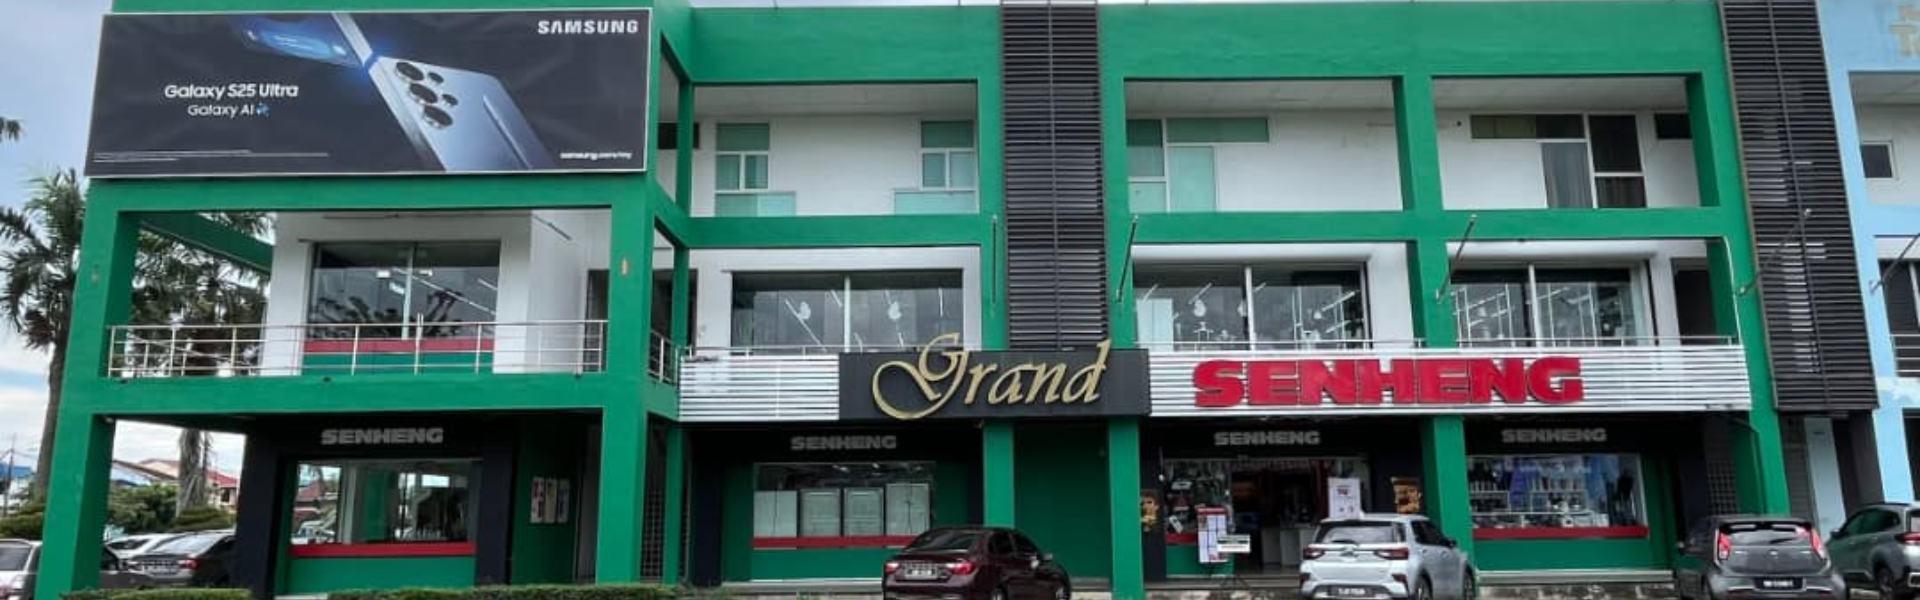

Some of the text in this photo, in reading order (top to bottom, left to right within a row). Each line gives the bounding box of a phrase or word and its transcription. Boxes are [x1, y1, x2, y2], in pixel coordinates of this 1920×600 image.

[538, 20, 639, 34] SAMSUNG
[164, 83, 299, 100] Galaxy S25 Ultra
[187, 104, 254, 118] Galaxy AI
[872, 333, 1110, 420] Grand
[1193, 356, 1584, 407] SENHENG
[321, 428, 443, 445] SENHENG
[791, 435, 896, 450] SENHENG
[1214, 431, 1320, 446] SENHENG
[1501, 428, 1607, 443] SENHENG
